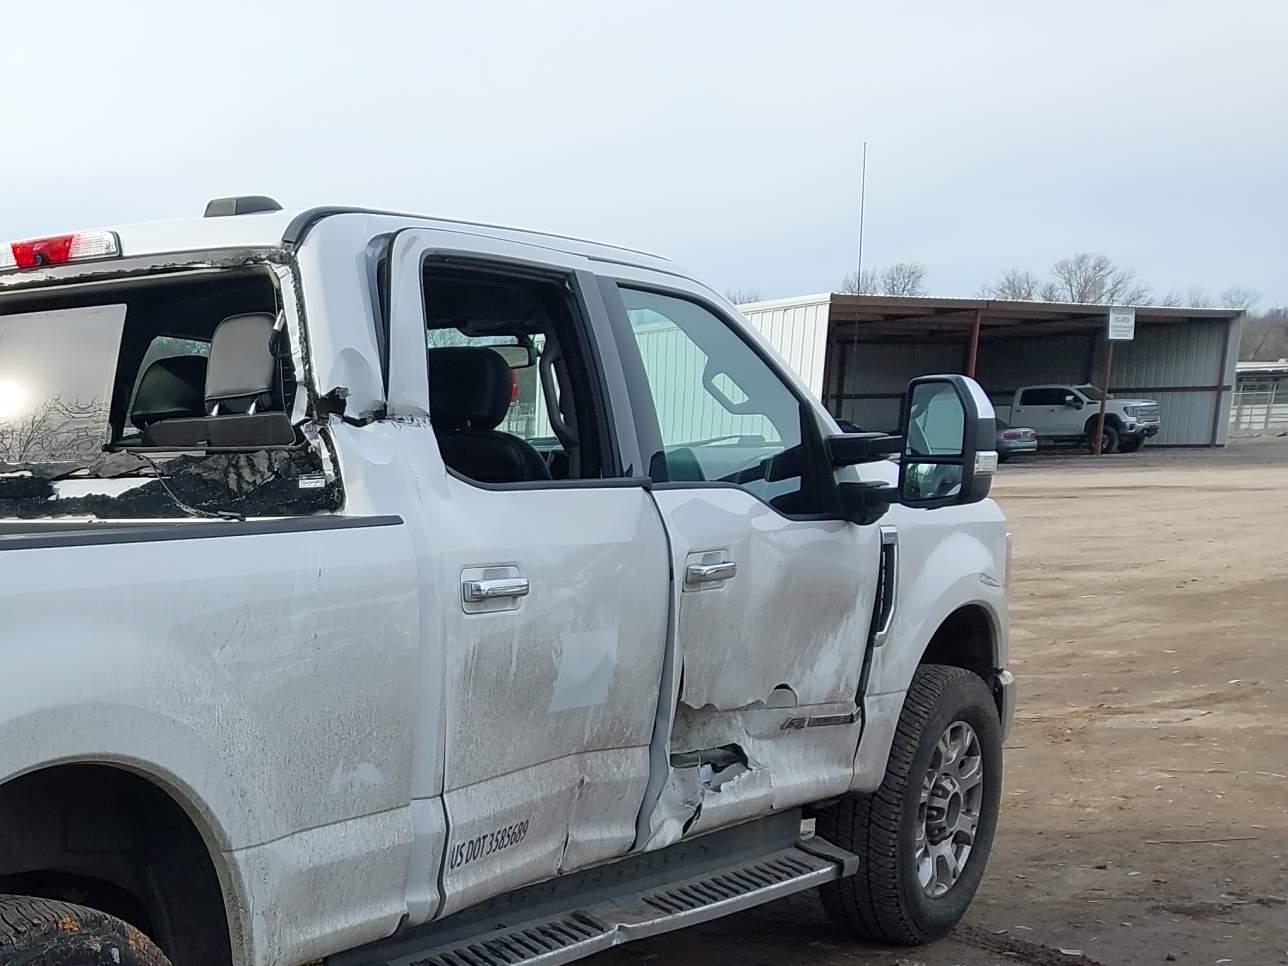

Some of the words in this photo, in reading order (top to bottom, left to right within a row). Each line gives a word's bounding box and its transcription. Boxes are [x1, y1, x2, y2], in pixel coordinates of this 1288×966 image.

[450, 841, 466, 870] US
[465, 834, 489, 864] DOT
[486, 819, 529, 855] 3585689
